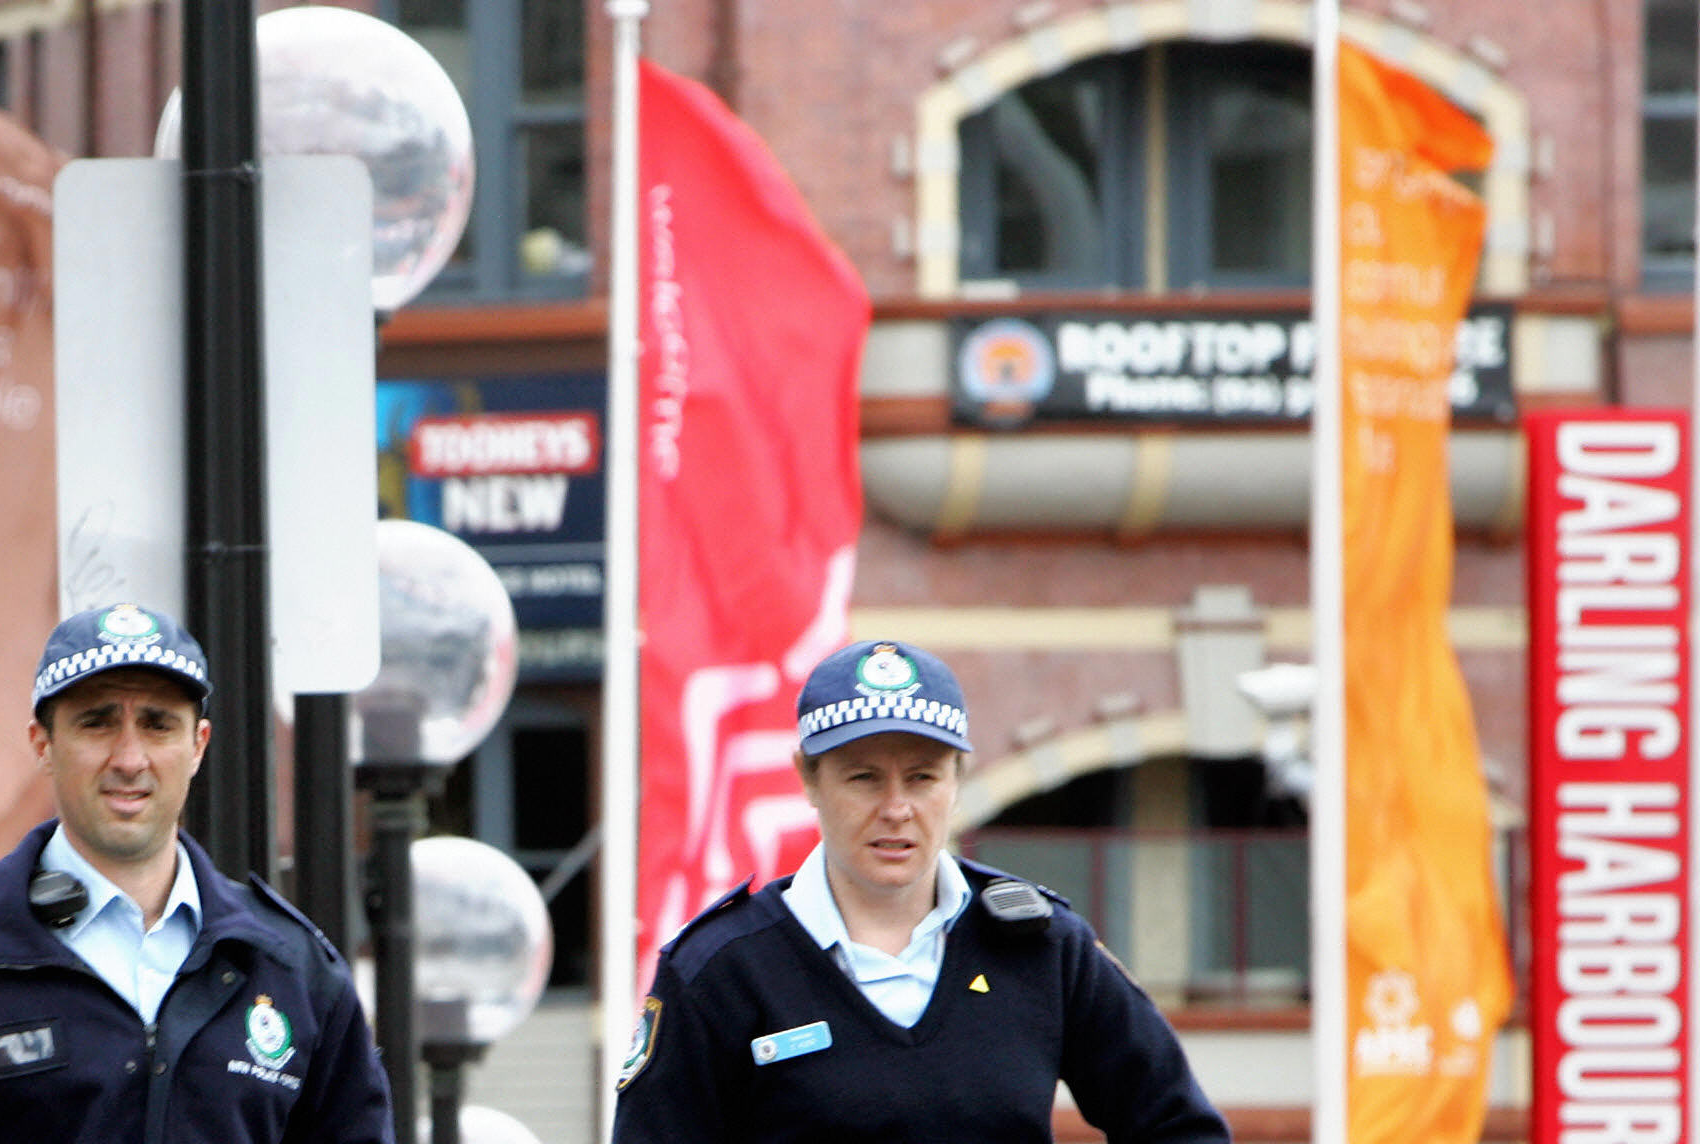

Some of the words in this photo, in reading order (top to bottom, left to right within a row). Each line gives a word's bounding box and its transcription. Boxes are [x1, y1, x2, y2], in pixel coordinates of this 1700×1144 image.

[1058, 321, 1287, 373] ROOFTOP
[441, 472, 569, 533] NEW
[1556, 421, 1681, 760] DARLING
